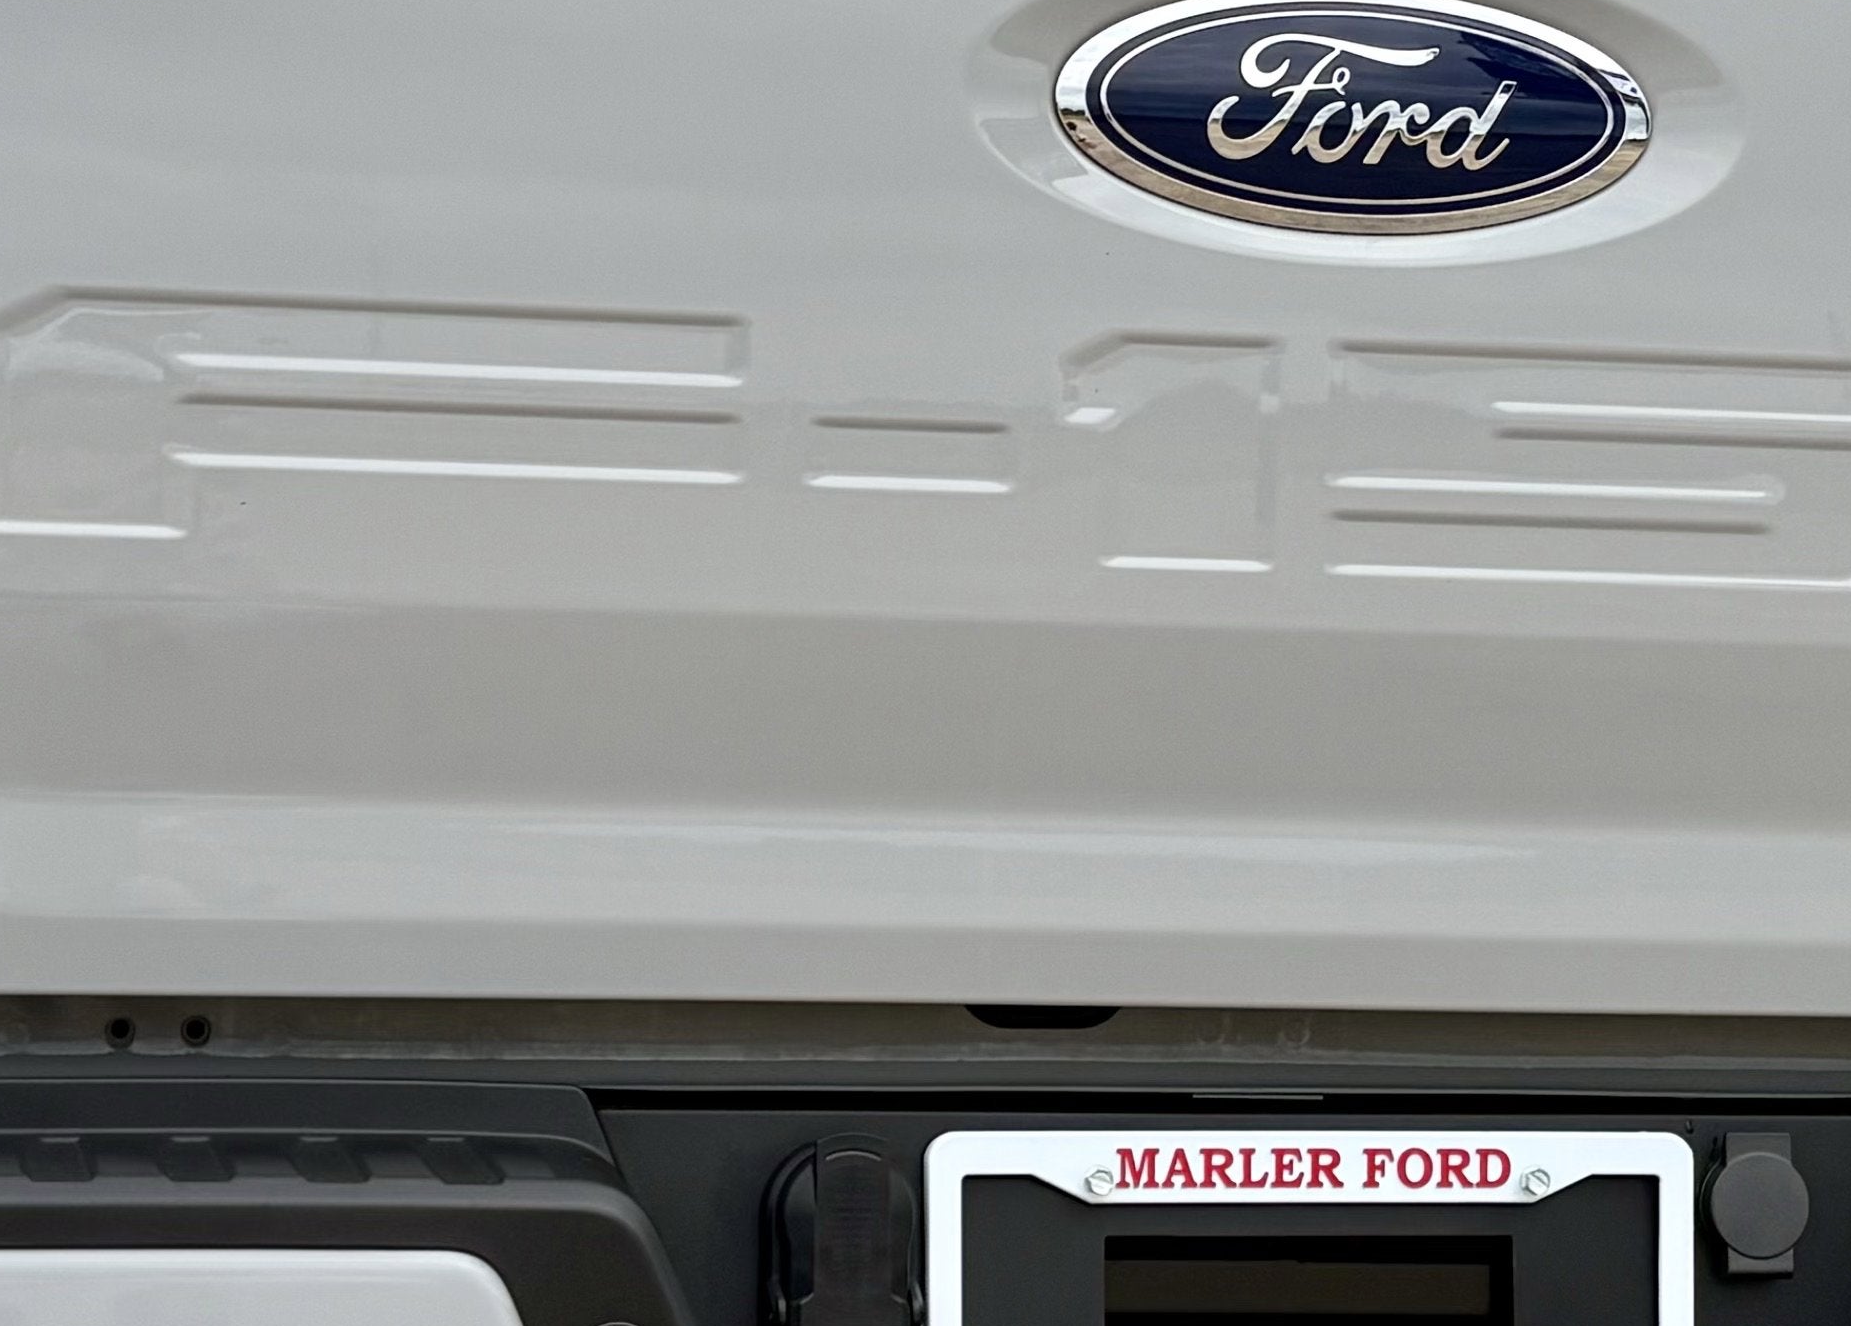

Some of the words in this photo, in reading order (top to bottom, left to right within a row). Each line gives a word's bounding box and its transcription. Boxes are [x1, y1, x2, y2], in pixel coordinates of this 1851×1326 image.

[1206, 32, 1517, 171] Ford
[1114, 1148, 1344, 1190] MARLER
[1363, 1148, 1512, 1190] FORD
